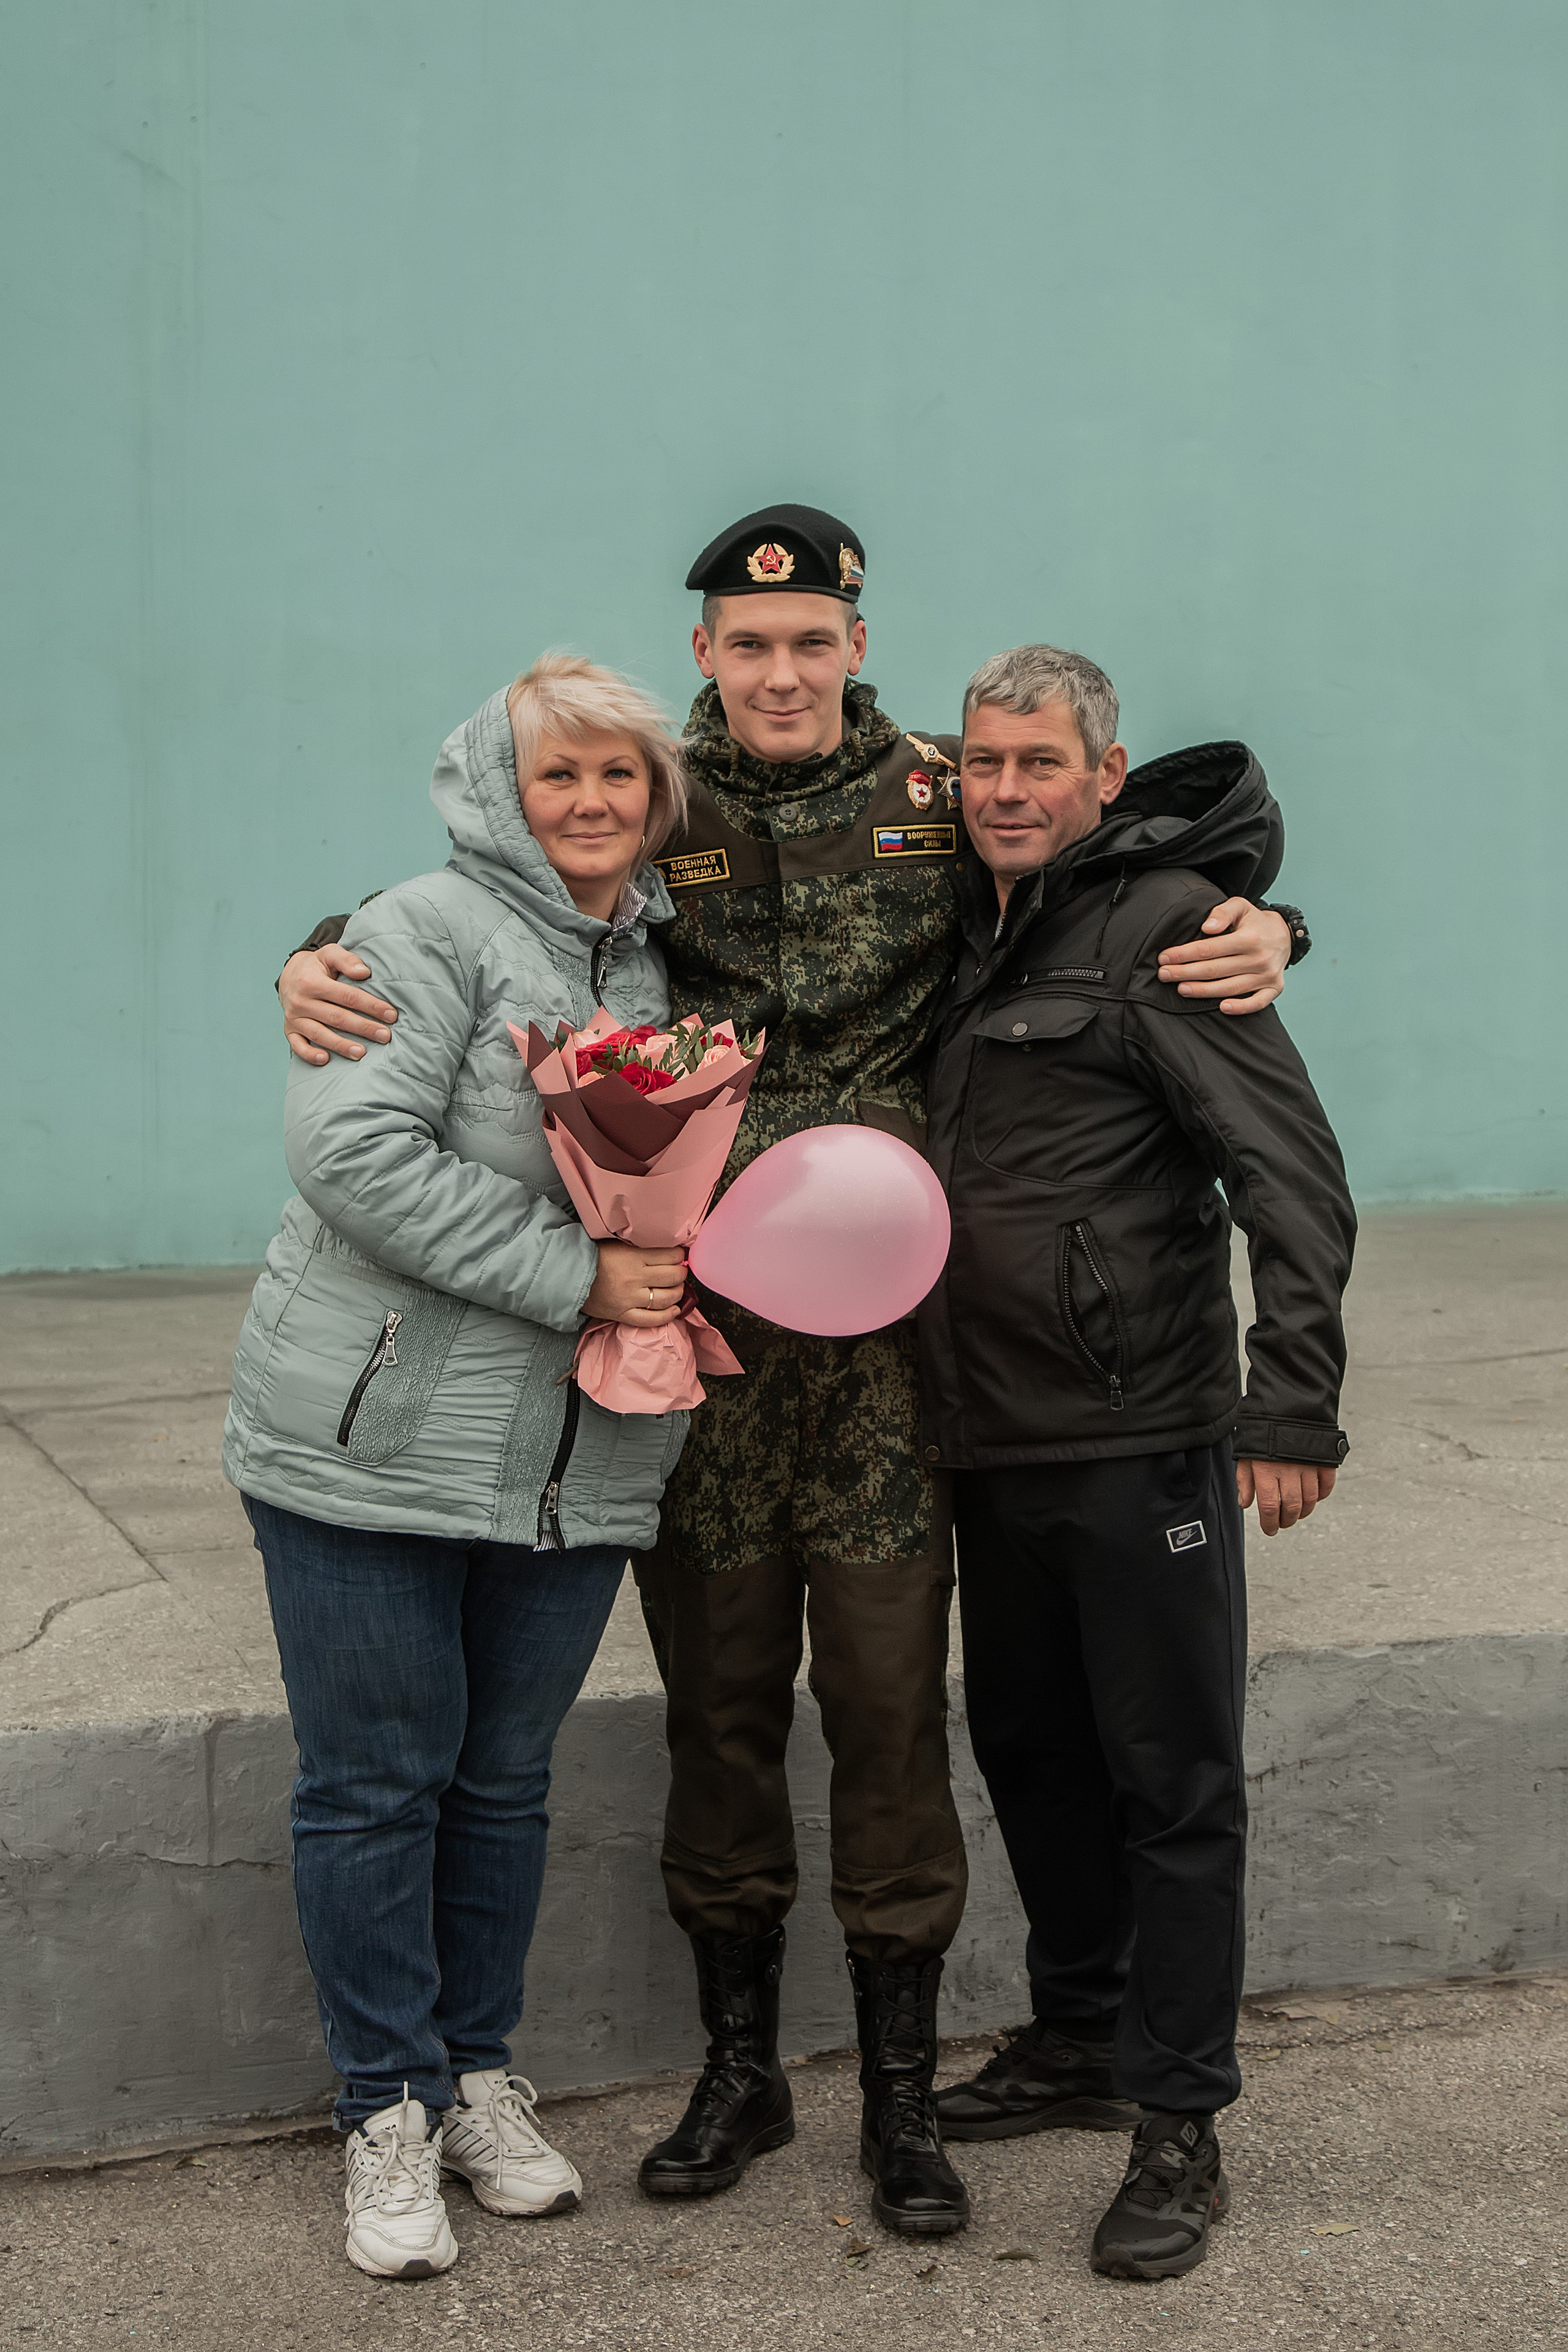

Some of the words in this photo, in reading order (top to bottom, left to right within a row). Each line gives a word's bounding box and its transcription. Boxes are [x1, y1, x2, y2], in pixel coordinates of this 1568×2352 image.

[671, 855, 716, 871] ВОЕННАЯ
[669, 865, 722, 882] РАЗВЕДКА
[1178, 1528, 1193, 1539] NIKE
